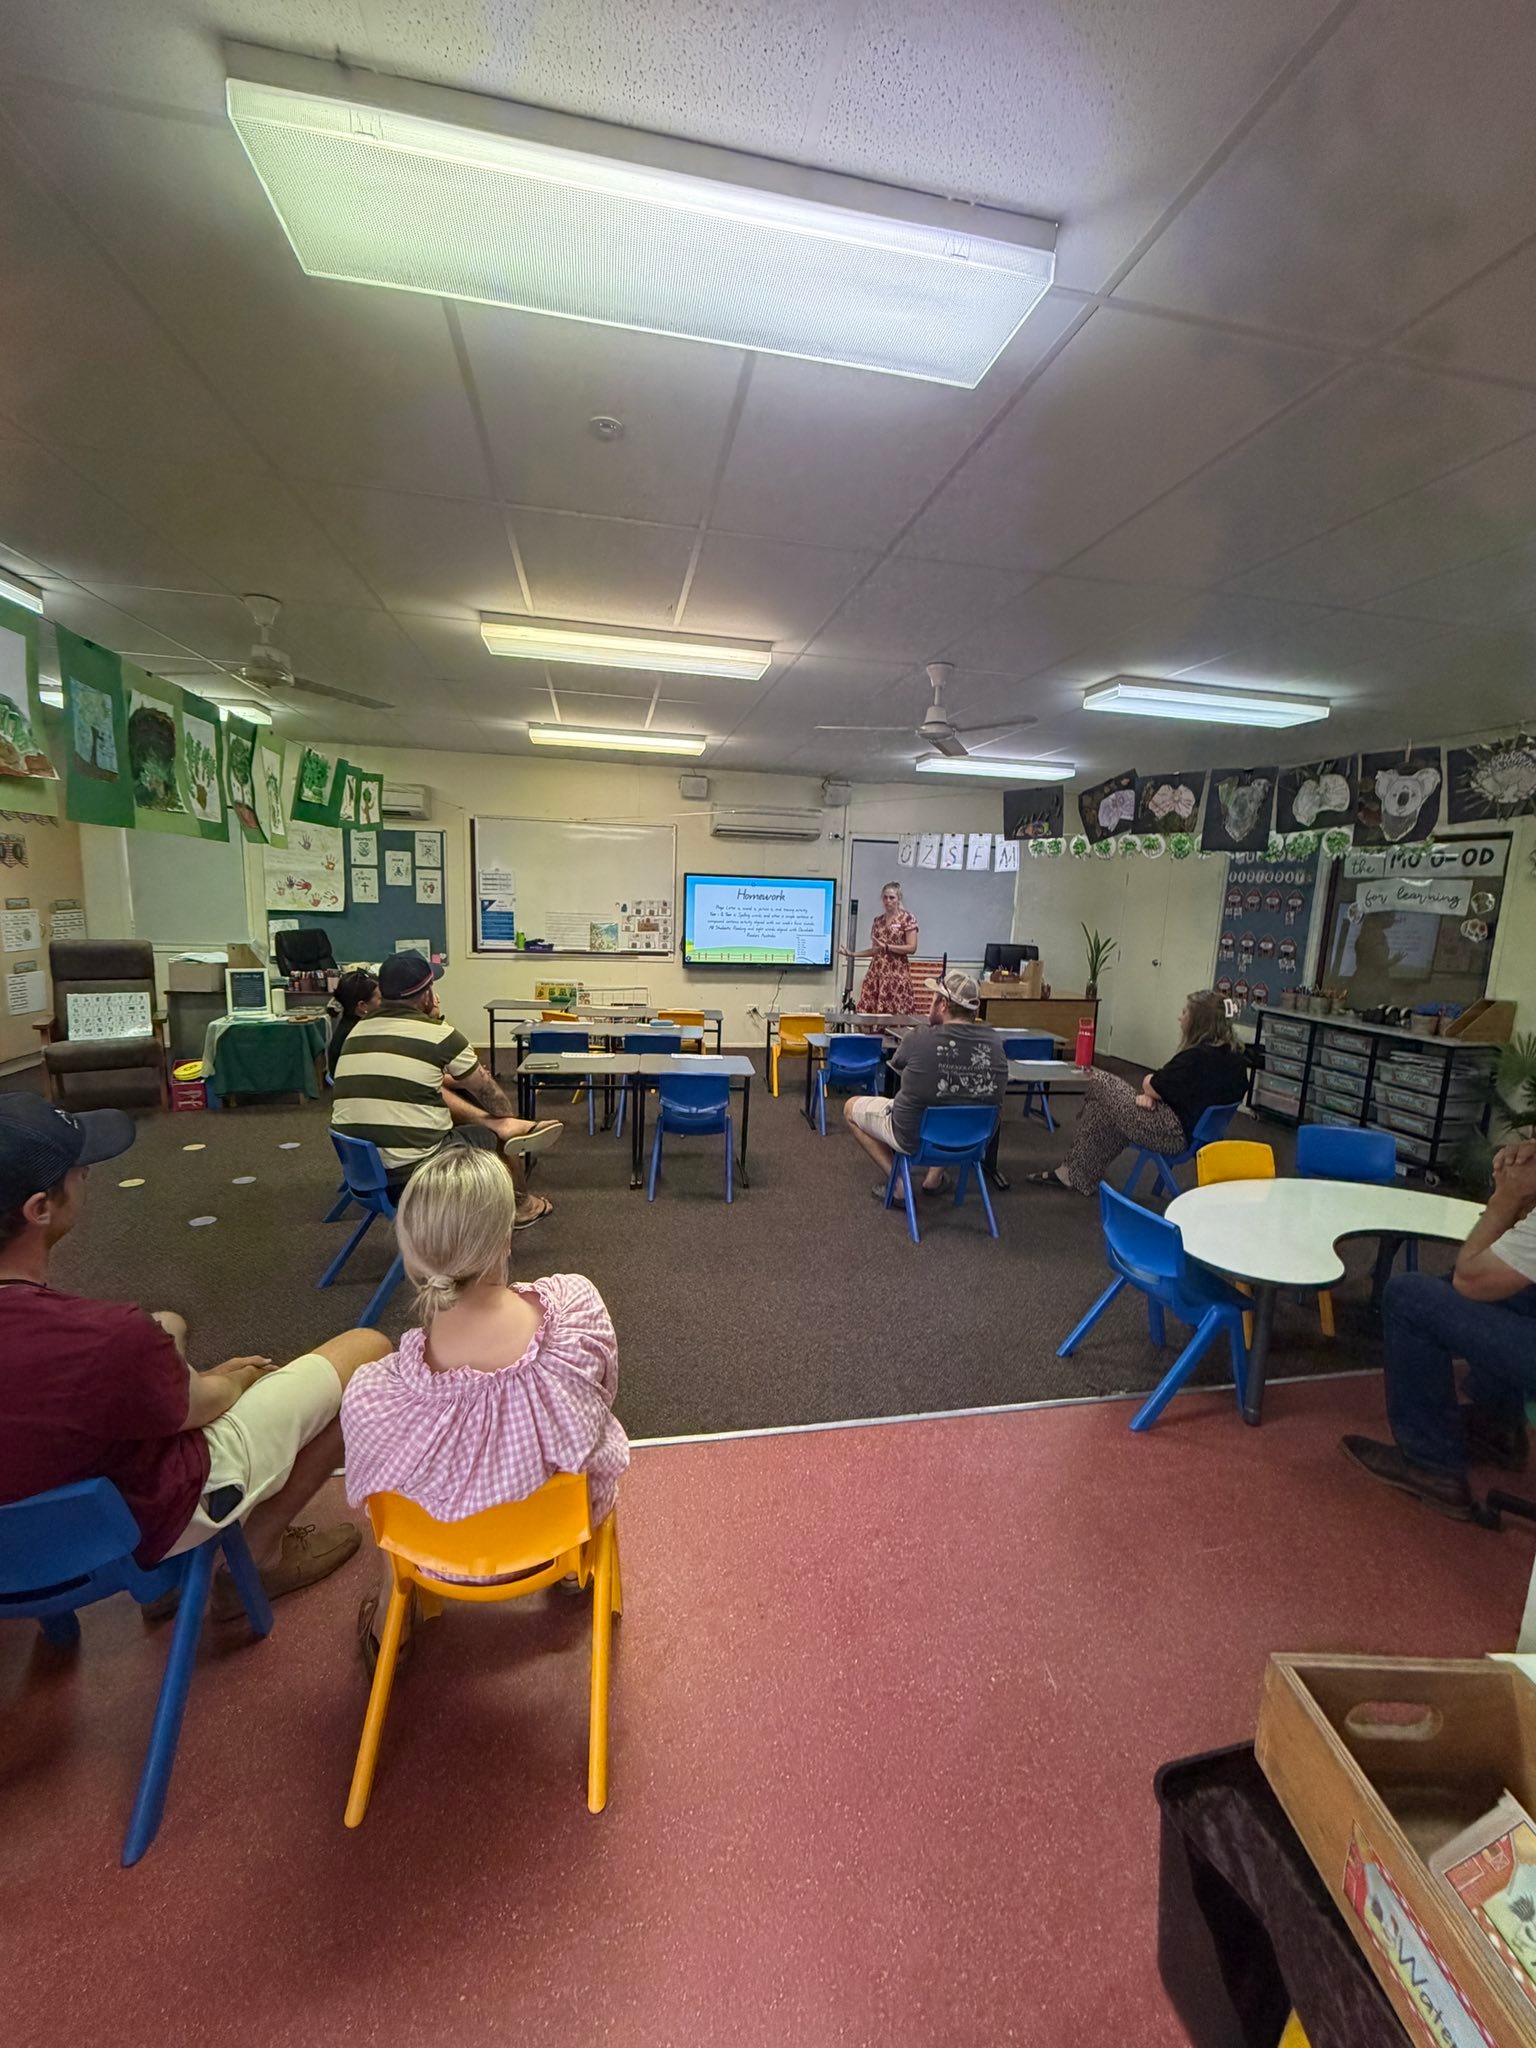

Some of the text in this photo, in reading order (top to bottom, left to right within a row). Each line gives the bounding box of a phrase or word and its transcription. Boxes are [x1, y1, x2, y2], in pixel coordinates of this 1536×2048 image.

[946, 845, 958, 867] S
[972, 846, 983, 865] F
[999, 846, 1016, 868] M
[1352, 857, 1375, 875] the
[737, 888, 786, 901] Homework
[1365, 887, 1462, 909] for learning
[1399, 1938, 1457, 2048] Wate
